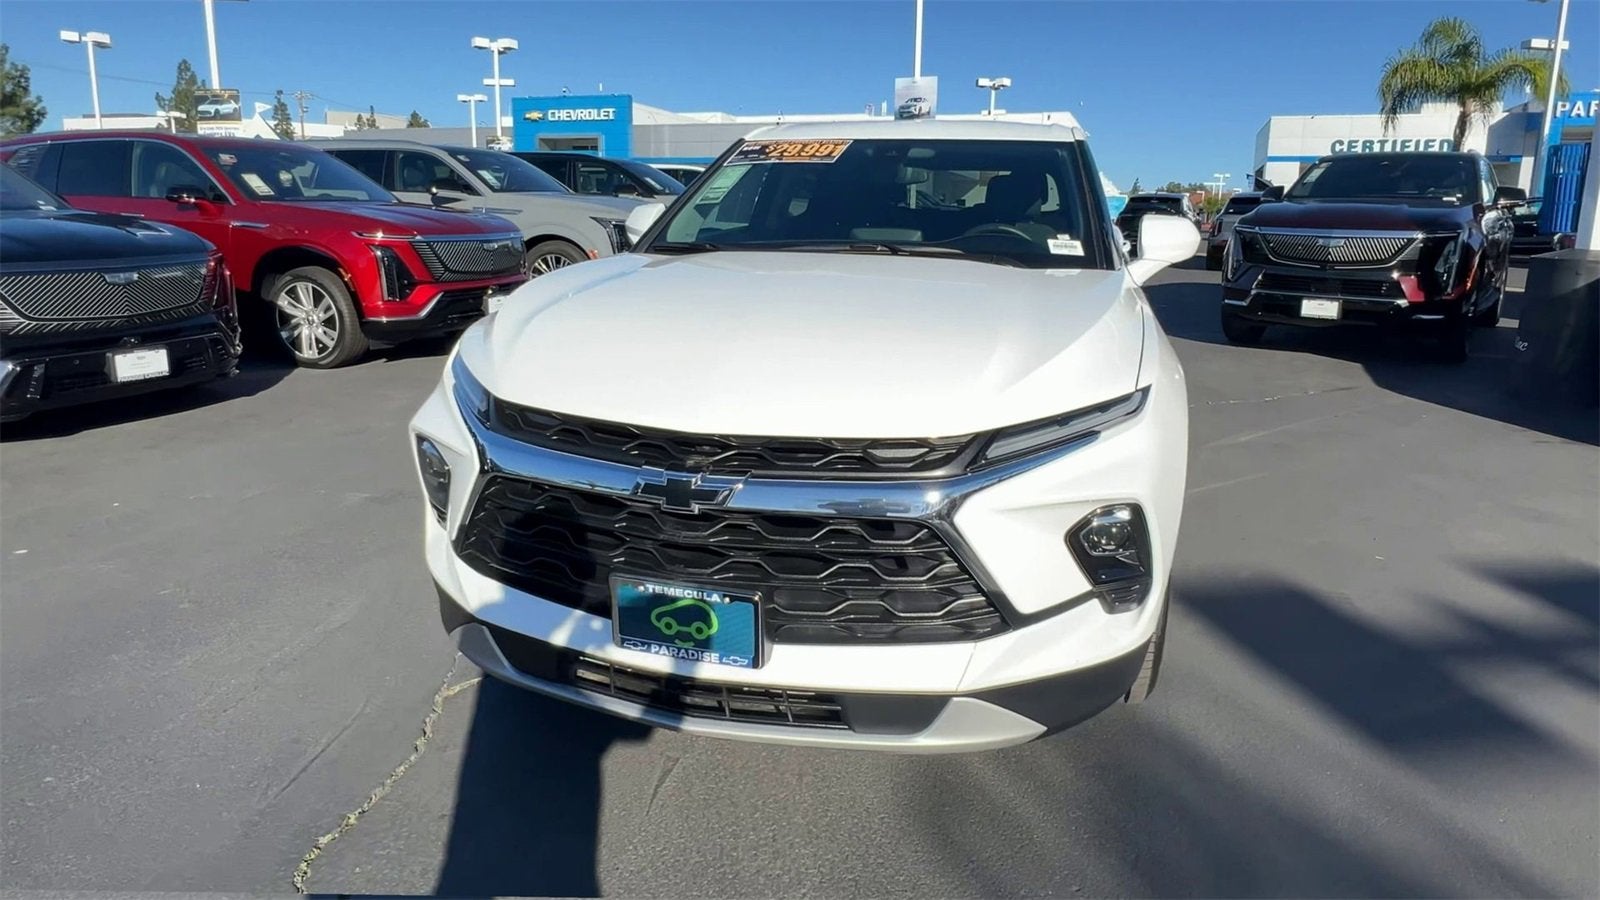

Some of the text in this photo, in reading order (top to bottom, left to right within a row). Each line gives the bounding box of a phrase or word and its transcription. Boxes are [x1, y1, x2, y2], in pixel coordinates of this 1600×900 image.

[548, 108, 616, 122] CHEVROLET
[1331, 138, 1455, 153] CERTIFIED
[645, 584, 721, 602] TEMECULA
[650, 643, 720, 663] PARADISE
